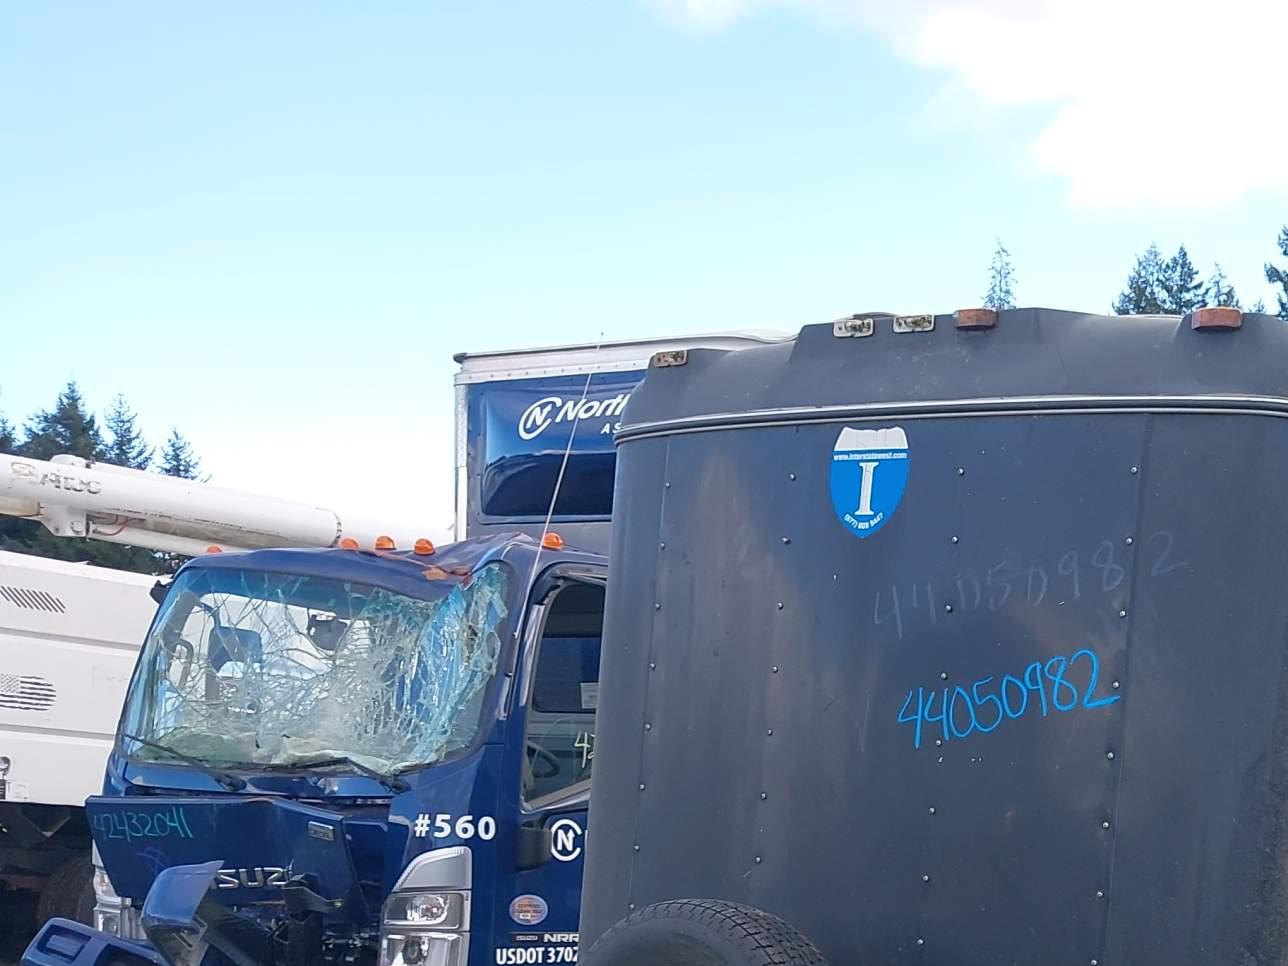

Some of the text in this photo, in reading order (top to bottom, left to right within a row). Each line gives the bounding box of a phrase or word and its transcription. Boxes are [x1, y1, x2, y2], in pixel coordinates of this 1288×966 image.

[897, 648, 1121, 749] 44050982
[93, 806, 194, 842] 42432041
[414, 812, 497, 841] #560
[495, 946, 545, 965] USDOT
